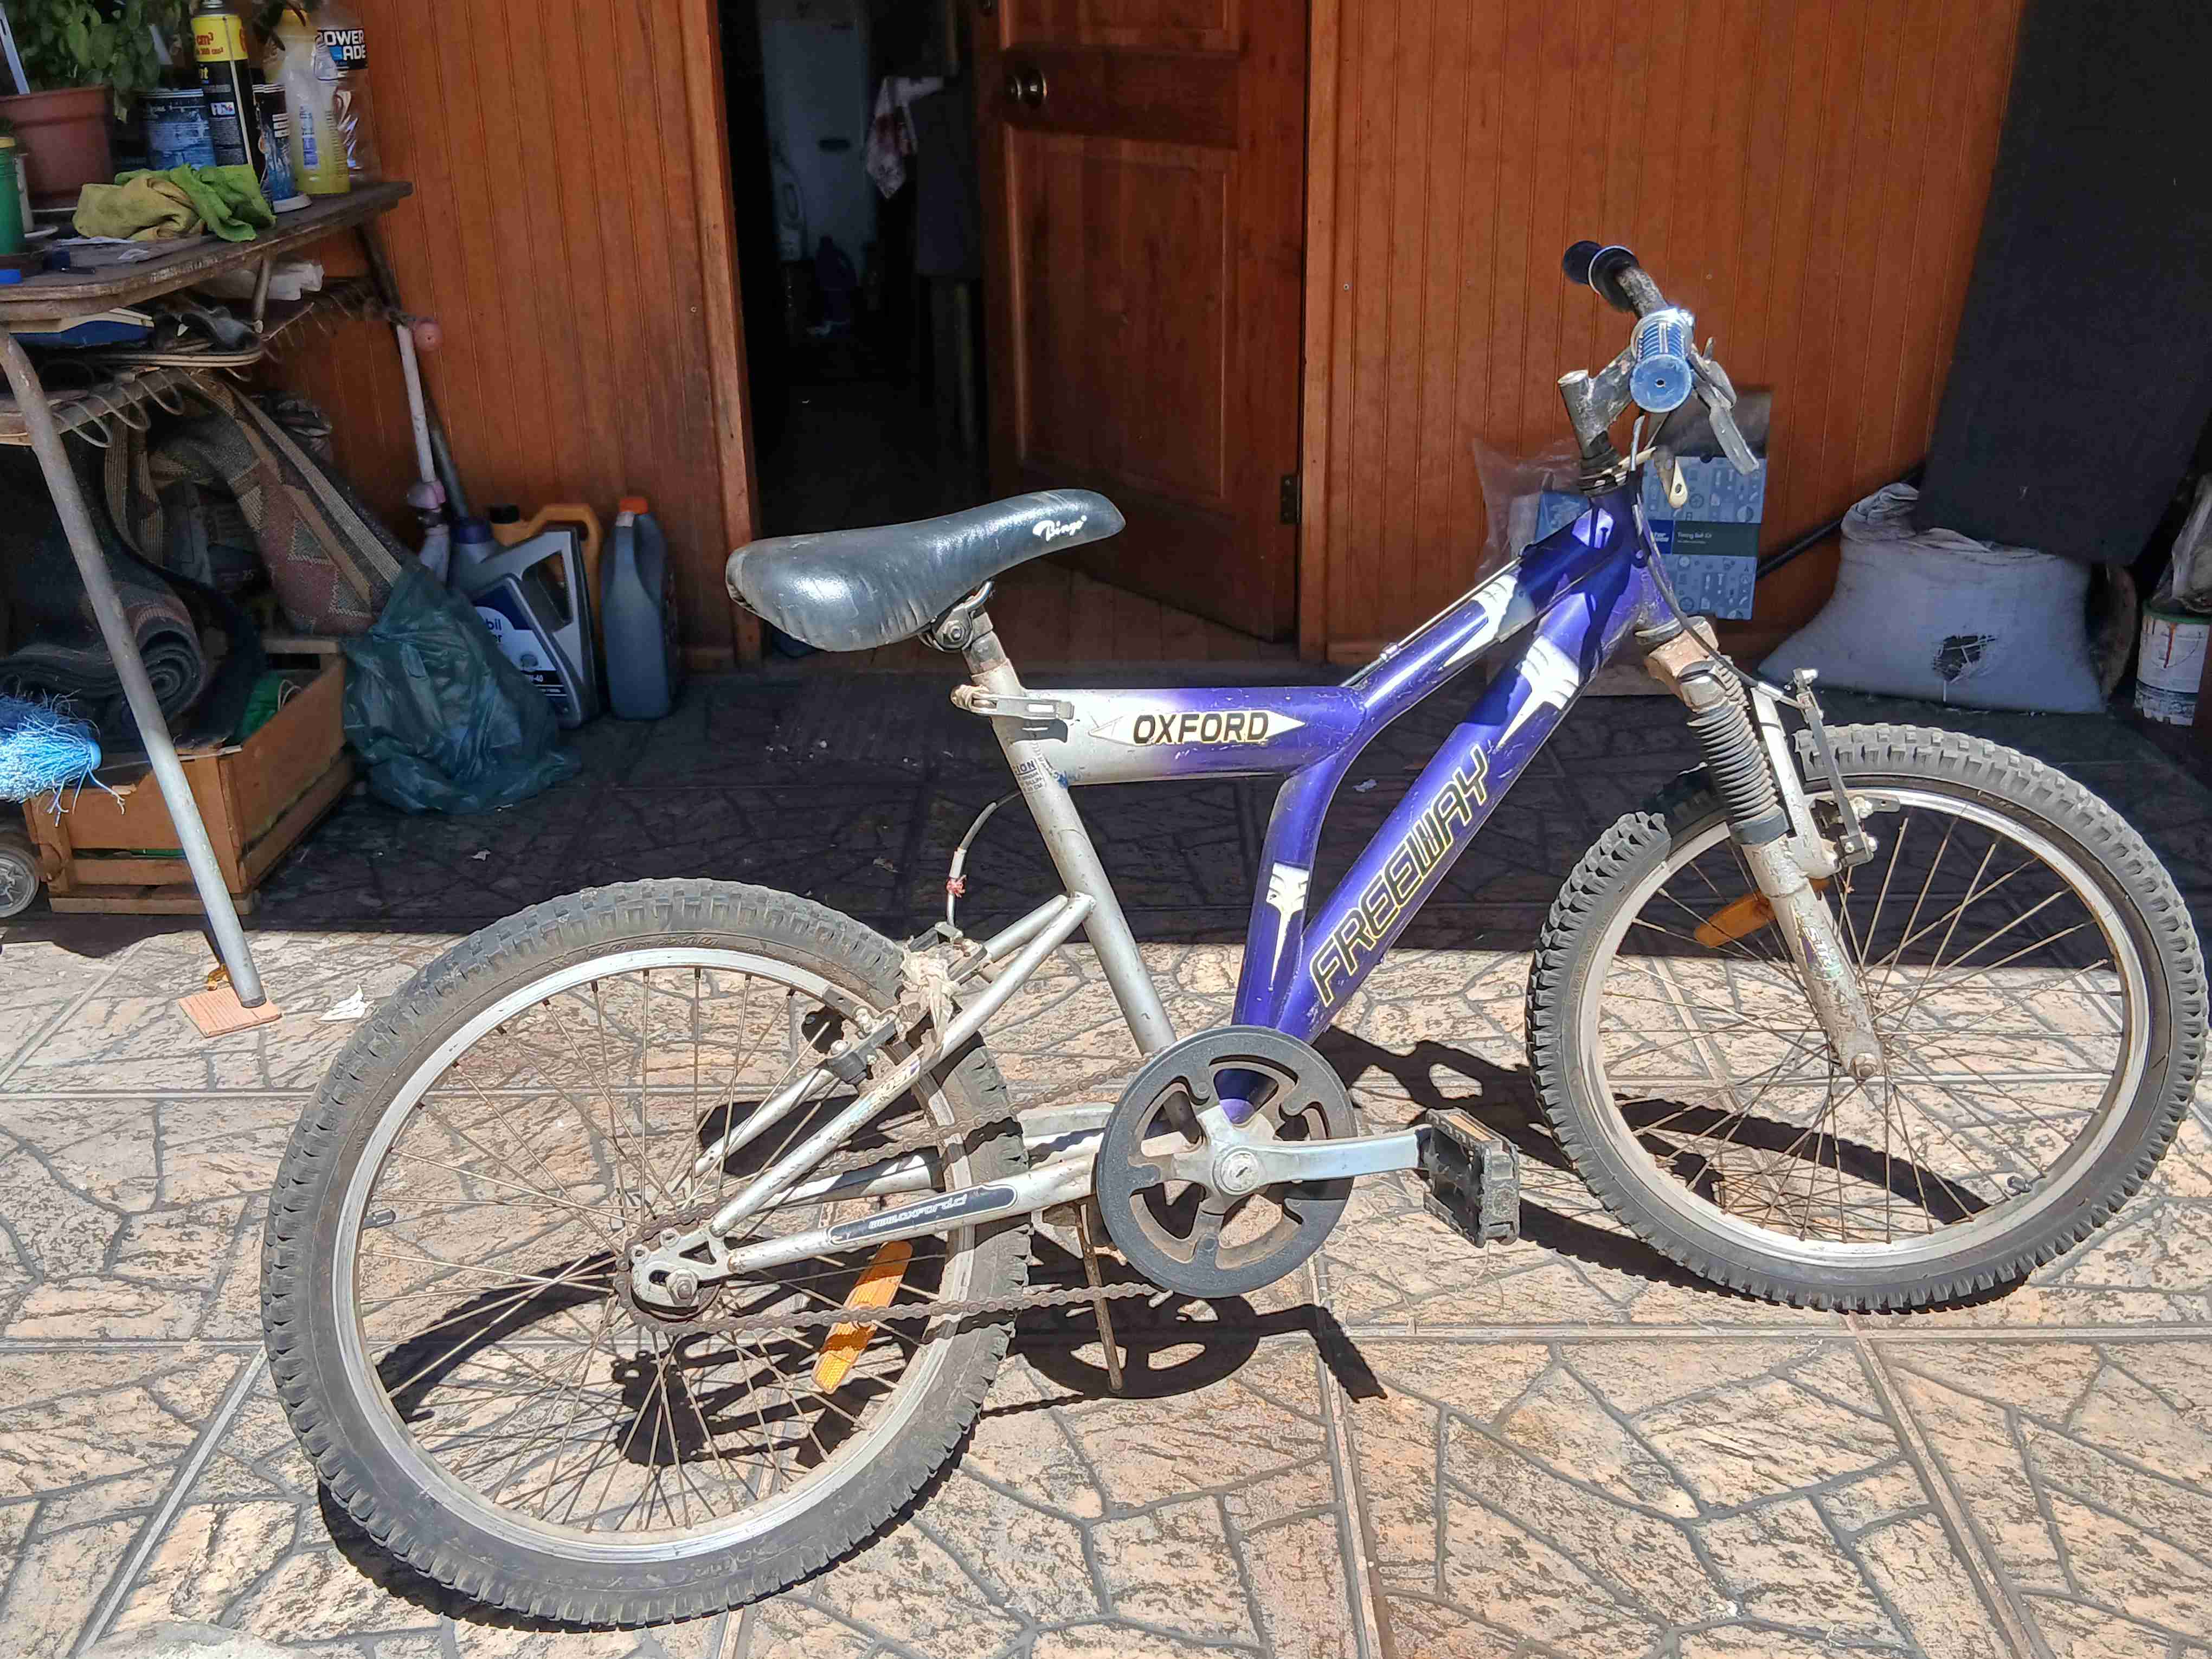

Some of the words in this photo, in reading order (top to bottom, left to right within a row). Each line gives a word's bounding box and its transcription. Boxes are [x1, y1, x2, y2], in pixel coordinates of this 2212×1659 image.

[343, 44, 366, 61] ADE
[485, 619, 501, 631] bil
[1133, 712, 1269, 744] OXFORD
[1309, 743, 1488, 1007] FREEWAY
